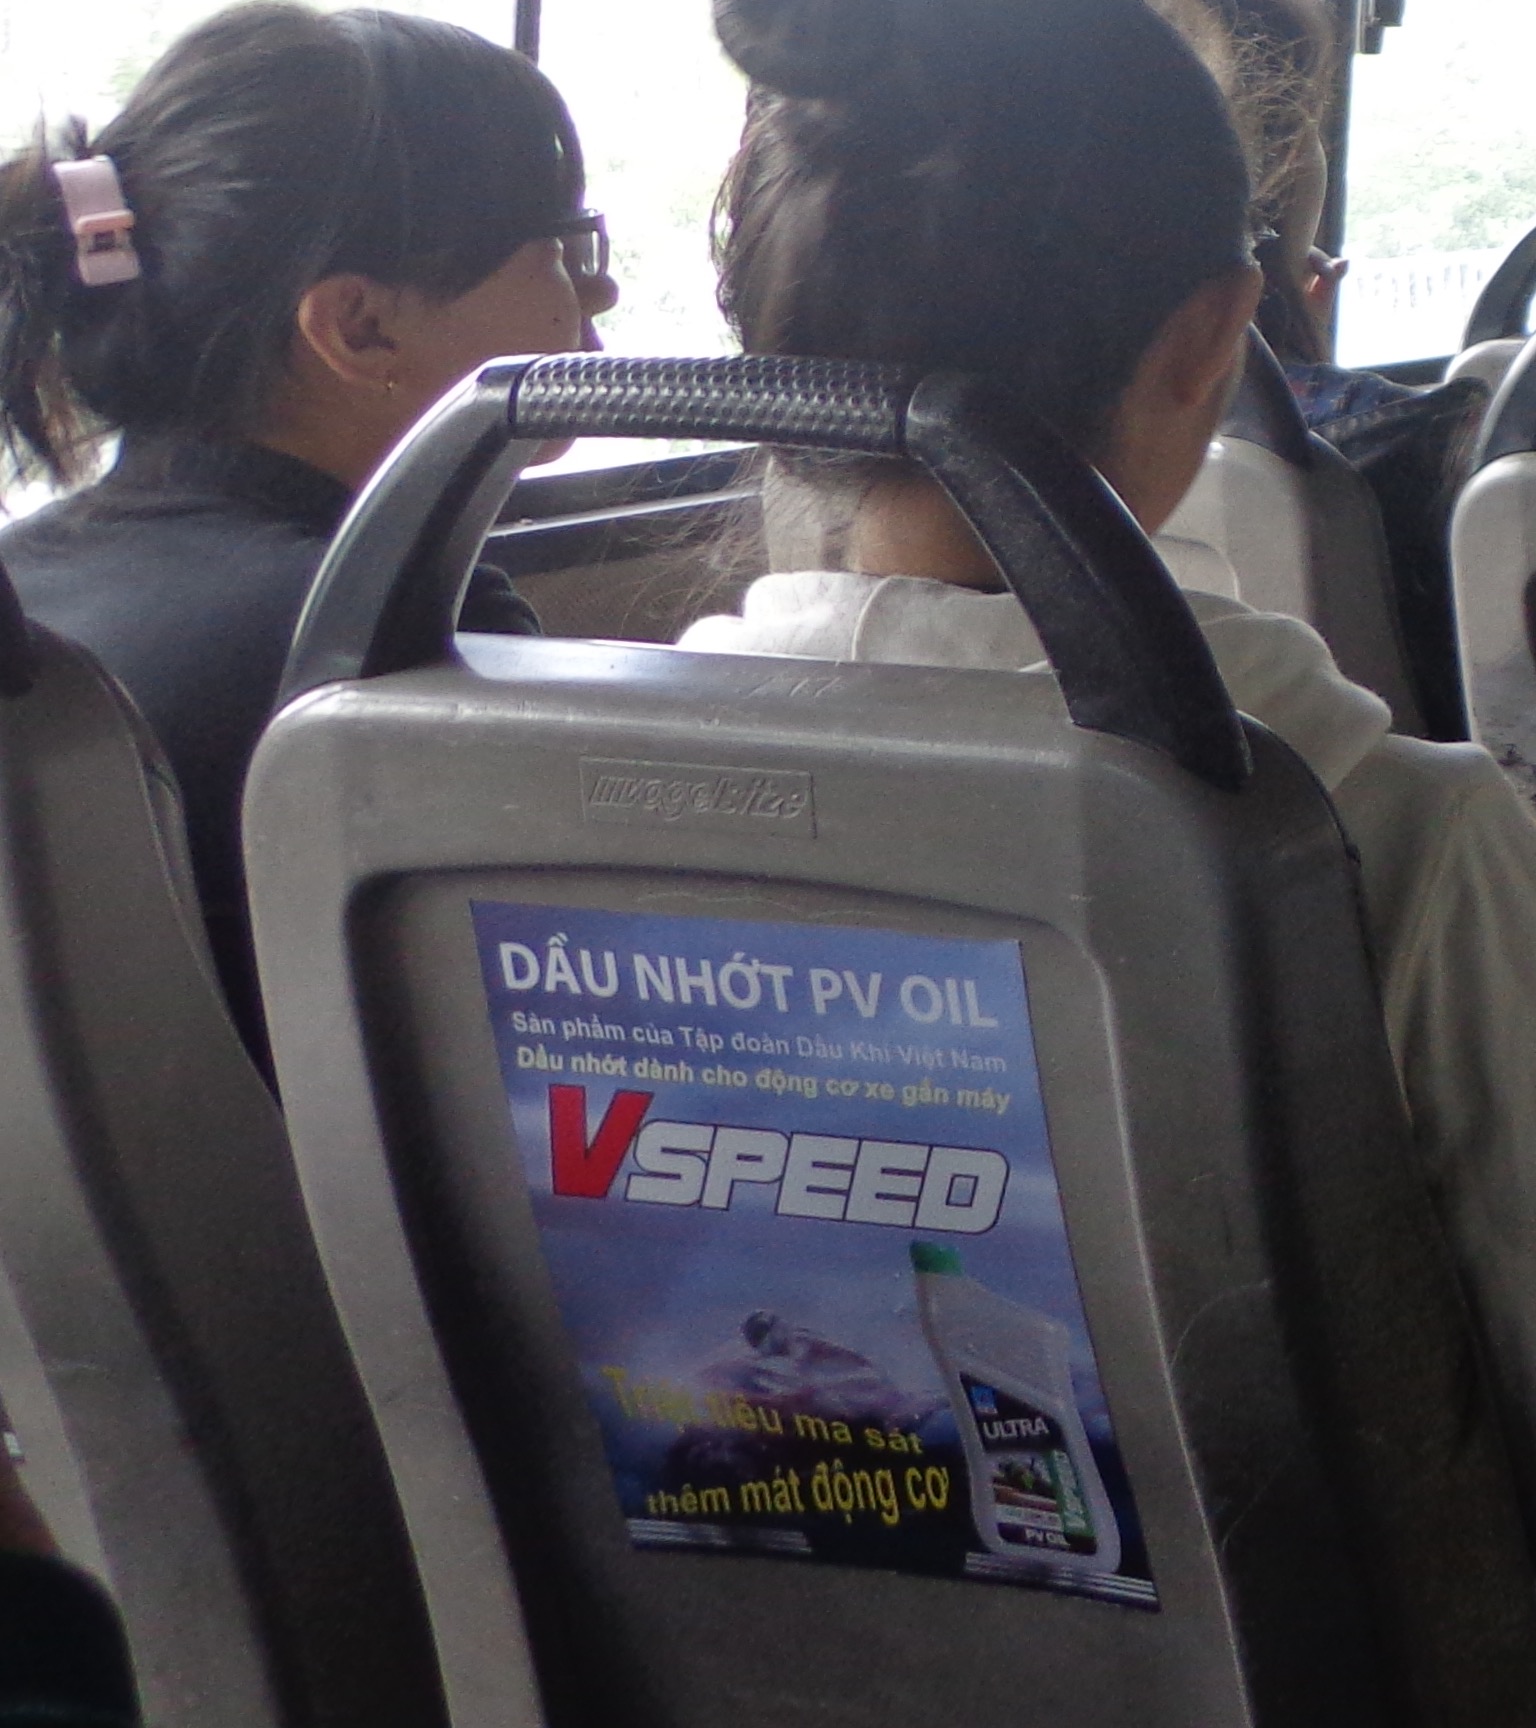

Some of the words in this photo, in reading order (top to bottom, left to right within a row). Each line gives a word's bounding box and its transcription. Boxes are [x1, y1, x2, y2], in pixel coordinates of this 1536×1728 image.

[500, 932, 619, 998] DẦU
[633, 951, 794, 1012] NHỚT
[809, 967, 882, 1018] PV
[901, 974, 998, 1028] OIL
[512, 1011, 555, 1035] Sản
[562, 1012, 625, 1041] phẩm
[632, 1022, 674, 1046] của
[679, 1026, 724, 1053] Tập
[731, 1031, 790, 1055] đoàn
[796, 1032, 843, 1059] Dầu
[851, 1042, 891, 1064] Khí
[899, 1044, 944, 1070] Việt
[952, 1050, 1008, 1073] Nam
[517, 1043, 563, 1071] Dầu
[571, 1050, 627, 1077] nhớt
[633, 1057, 694, 1083] dành
[702, 1064, 748, 1087] cho
[755, 1068, 818, 1098] động
[826, 1078, 859, 1097] cơ
[864, 1080, 895, 1100] xe
[902, 1076, 949, 1107] gắn
[957, 1088, 1011, 1115] máy
[548, 1083, 1009, 1235] VSPEED
[794, 1413, 852, 1443] ma
[865, 1427, 924, 1455] sát
[983, 1417, 1049, 1439] ULTRA
[647, 1483, 730, 1515] thêm
[740, 1465, 805, 1514] mát
[812, 1458, 900, 1524] động
[905, 1465, 950, 1511] cơ
[1025, 1528, 1041, 1543] PV
